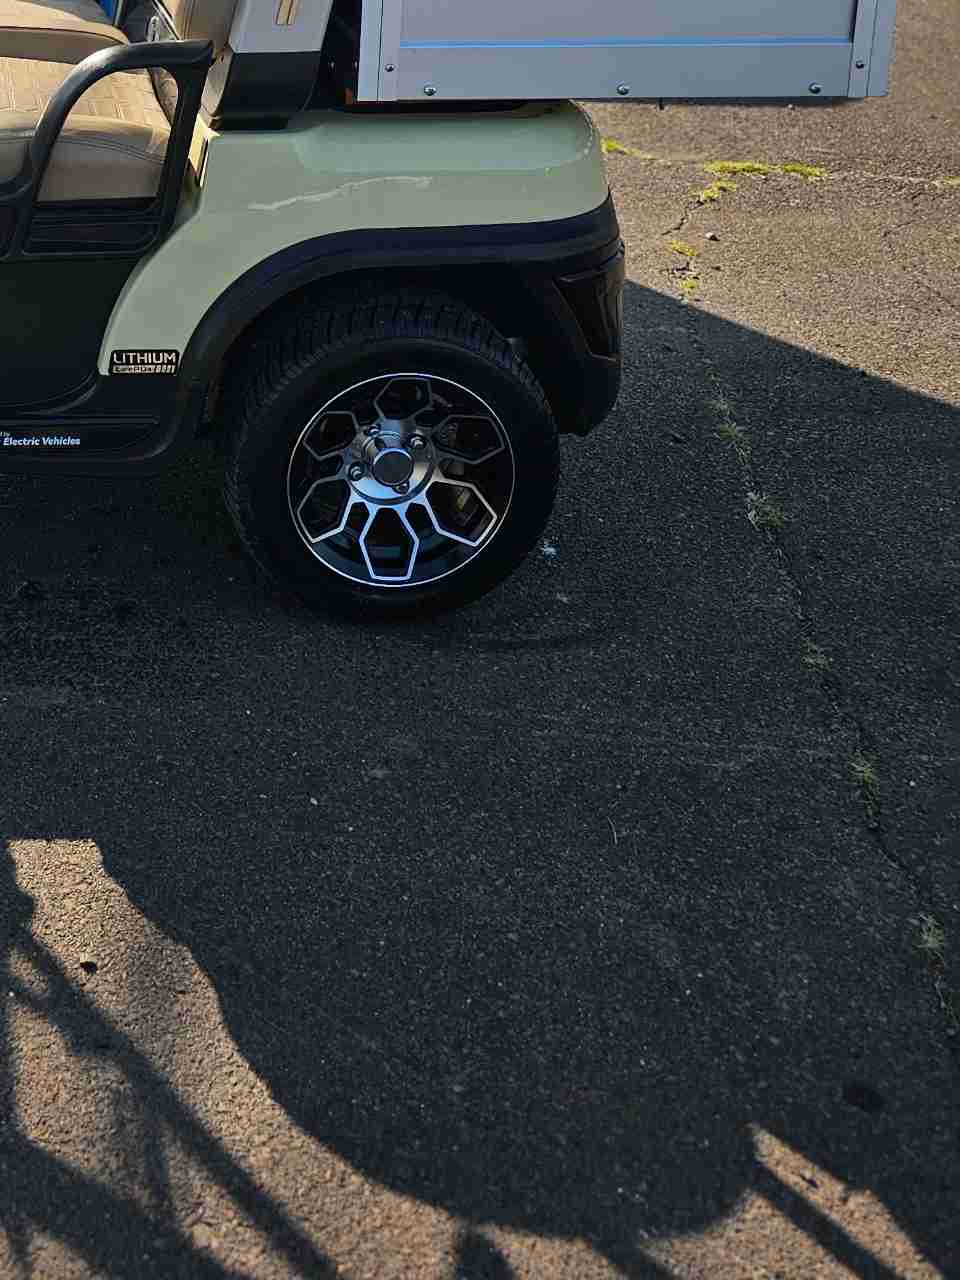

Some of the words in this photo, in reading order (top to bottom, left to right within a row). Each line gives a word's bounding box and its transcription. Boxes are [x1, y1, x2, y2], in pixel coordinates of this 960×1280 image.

[113, 352, 176, 364] LITHIUM
[3, 436, 40, 446] Electric
[41, 435, 81, 446] Vehicles
